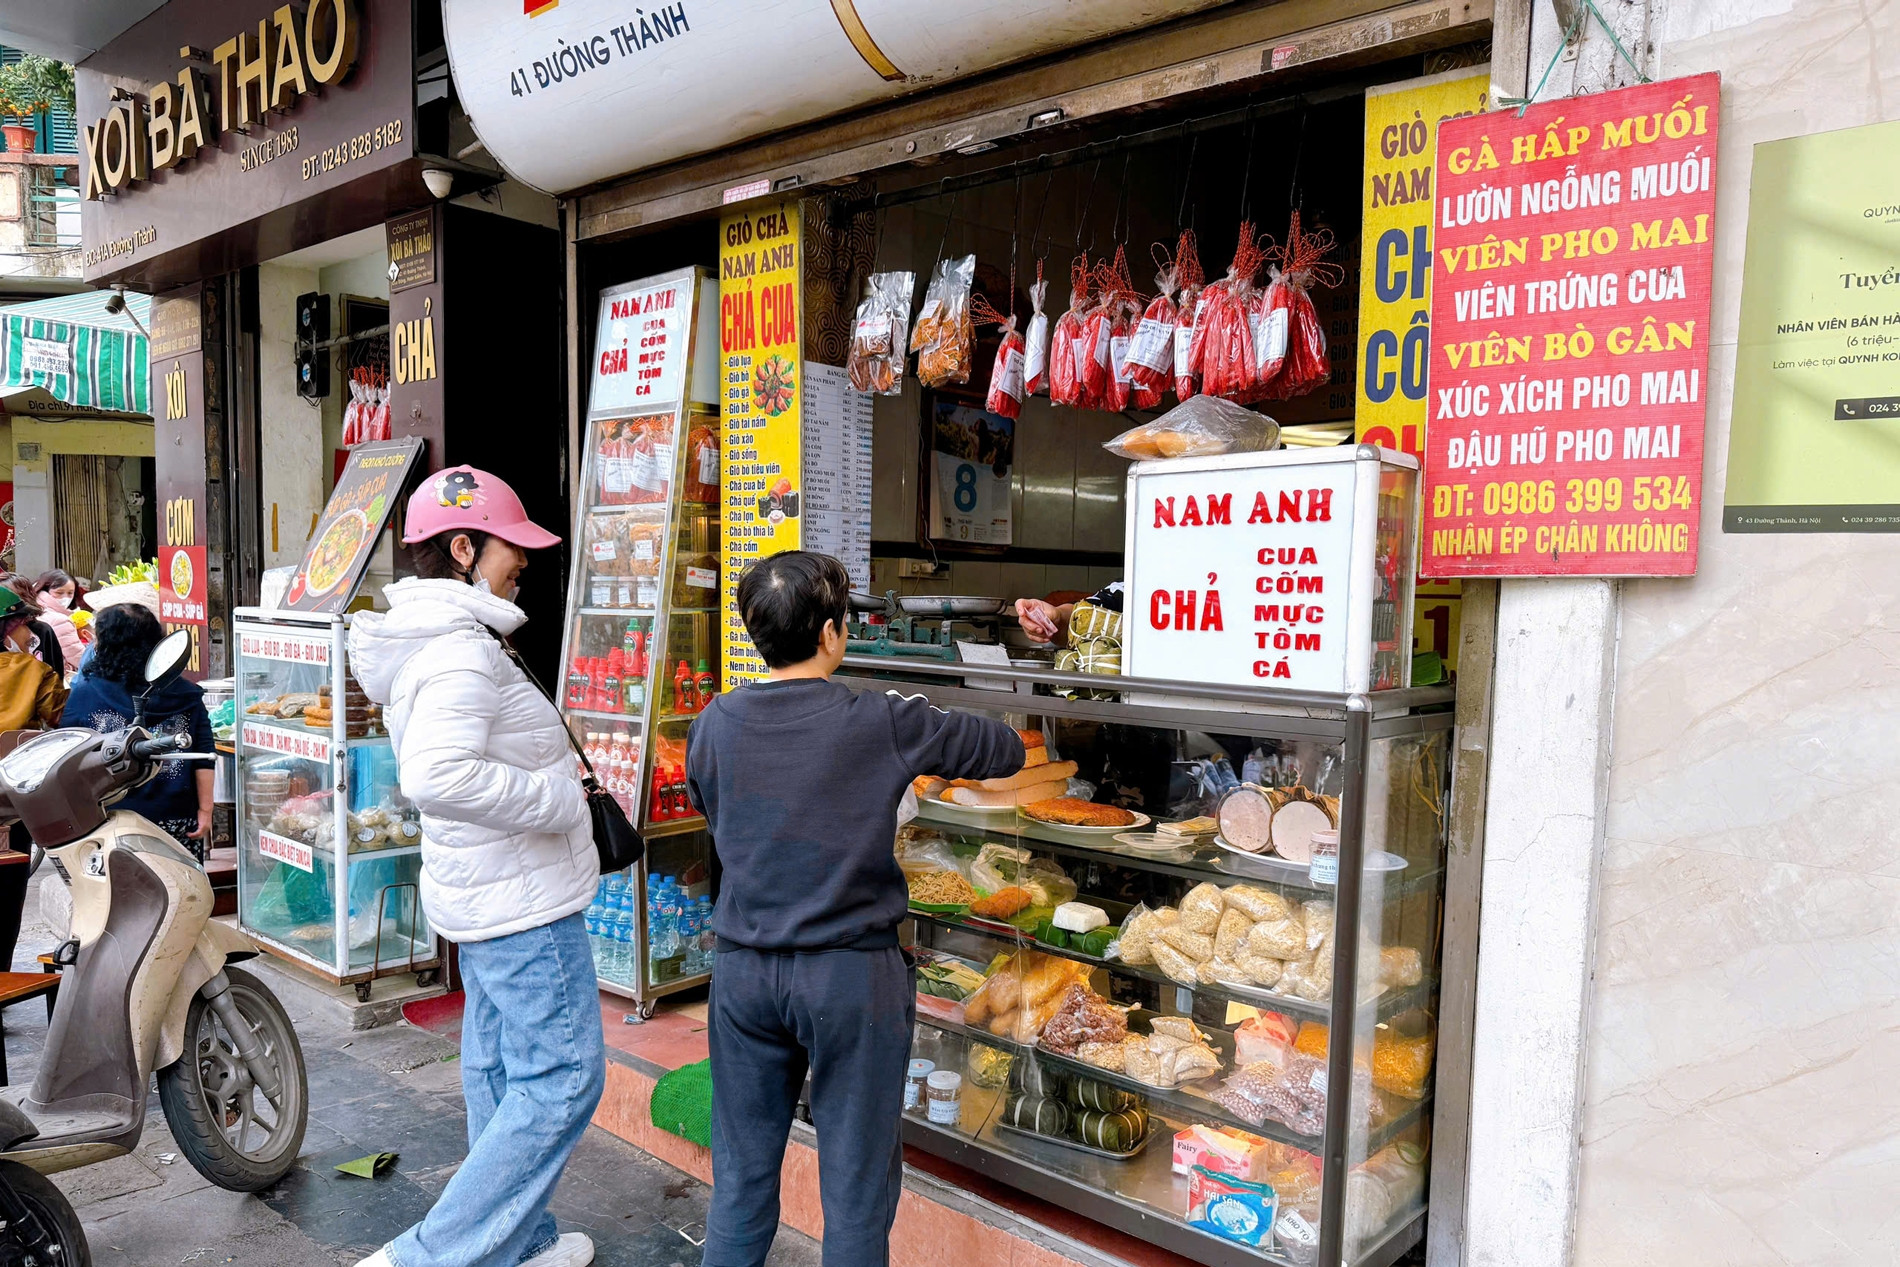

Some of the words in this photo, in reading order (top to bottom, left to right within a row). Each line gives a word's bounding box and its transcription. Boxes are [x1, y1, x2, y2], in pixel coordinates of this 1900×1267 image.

[510, 68, 532, 97] 41
[533, 38, 611, 89] ĐƯỜNG
[610, 1, 690, 57] THÀNH
[83, 88, 147, 201] XÔI
[149, 45, 207, 171] BÀ
[1381, 110, 1427, 160] GIÒ
[1447, 135, 1500, 176] GÀ
[1509, 116, 1591, 165] HẤP
[1601, 93, 1709, 150] MUỐI
[240, 143, 274, 173] SINCE
[275, 126, 299, 159] 1983
[302, 155, 321, 180] ĐT:
[322, 143, 348, 173] 0243
[350, 132, 372, 158] 828
[375, 119, 402, 151] 5182
[1371, 166, 1431, 208] NAM
[1442, 183, 1512, 228] LƯỜN
[1521, 164, 1621, 216] NGỖNG
[1630, 145, 1711, 201] MUỐI
[726, 214, 753, 247] GIÒ
[756, 203, 789, 241] CHẢ
[1439, 234, 1529, 274] VIÊN
[1540, 226, 1618, 262] PHO
[1630, 213, 1710, 252] MAI
[722, 252, 756, 281] NAM
[760, 242, 795, 275] ANH
[610, 296, 642, 320] NAM
[643, 288, 676, 314] ANH
[721, 278, 756, 353] CHẢ
[761, 282, 796, 348] CUA
[1454, 280, 1515, 323] VIÊN
[1524, 270, 1618, 314] TRỨNG
[1628, 265, 1687, 304] CUA
[394, 297, 437, 385] CHẢ
[641, 332, 666, 348] CỐM
[643, 319, 666, 332] CUA
[1443, 330, 1532, 370] VIÊN
[1543, 322, 1595, 361] BÒ
[1606, 315, 1697, 356] GÂN
[1777, 321, 1814, 335] NHÂN
[1818, 317, 1847, 331] VIÊN
[1851, 315, 1879, 328] BÁN
[600, 338, 628, 376] CHẢ
[638, 365, 662, 381] TÔM
[639, 350, 666, 366] MỰC
[1773, 361, 1795, 369] Làm
[1797, 358, 1819, 368] việc
[1822, 356, 1836, 367] tại
[1838, 353, 1879, 365] QUYNH
[165, 361, 188, 421] XÔI
[636, 380, 651, 396] CÁ
[1436, 379, 1490, 420] XÚC
[1497, 374, 1564, 415] XÍCH
[1572, 373, 1631, 410] PHO
[1640, 368, 1699, 405] MAI
[1869, 404, 1889, 413] 024
[1448, 429, 1502, 474] ĐẬU
[1510, 425, 1547, 465] HŨ
[1556, 428, 1613, 463] PHO
[1622, 424, 1681, 460] MAI
[954, 463, 977, 513] 8
[1153, 492, 1232, 528] NAM
[1247, 488, 1333, 524] ANH
[1432, 484, 1474, 518] ĐT:
[1483, 479, 1556, 516] 0986
[1565, 477, 1623, 513] 399
[1633, 475, 1692, 511] 534
[166, 496, 195, 547] CƠM
[1432, 523, 1493, 562] NHẬN
[1500, 521, 1528, 555] ÉP
[1535, 519, 1598, 554] CHÂN
[1605, 517, 1688, 552] KHÔNG
[1257, 547, 1318, 565] CUA
[1150, 571, 1224, 632] CHẢ
[1256, 569, 1323, 594] CỐM
[1254, 603, 1324, 627] MỰC
[1254, 628, 1321, 651] TÔM
[1253, 656, 1292, 679] CÁ
[1177, 1141, 1198, 1154] Fairy
[1203, 1188, 1220, 1202] HẢI
[1222, 1195, 1241, 1210] SẢN
